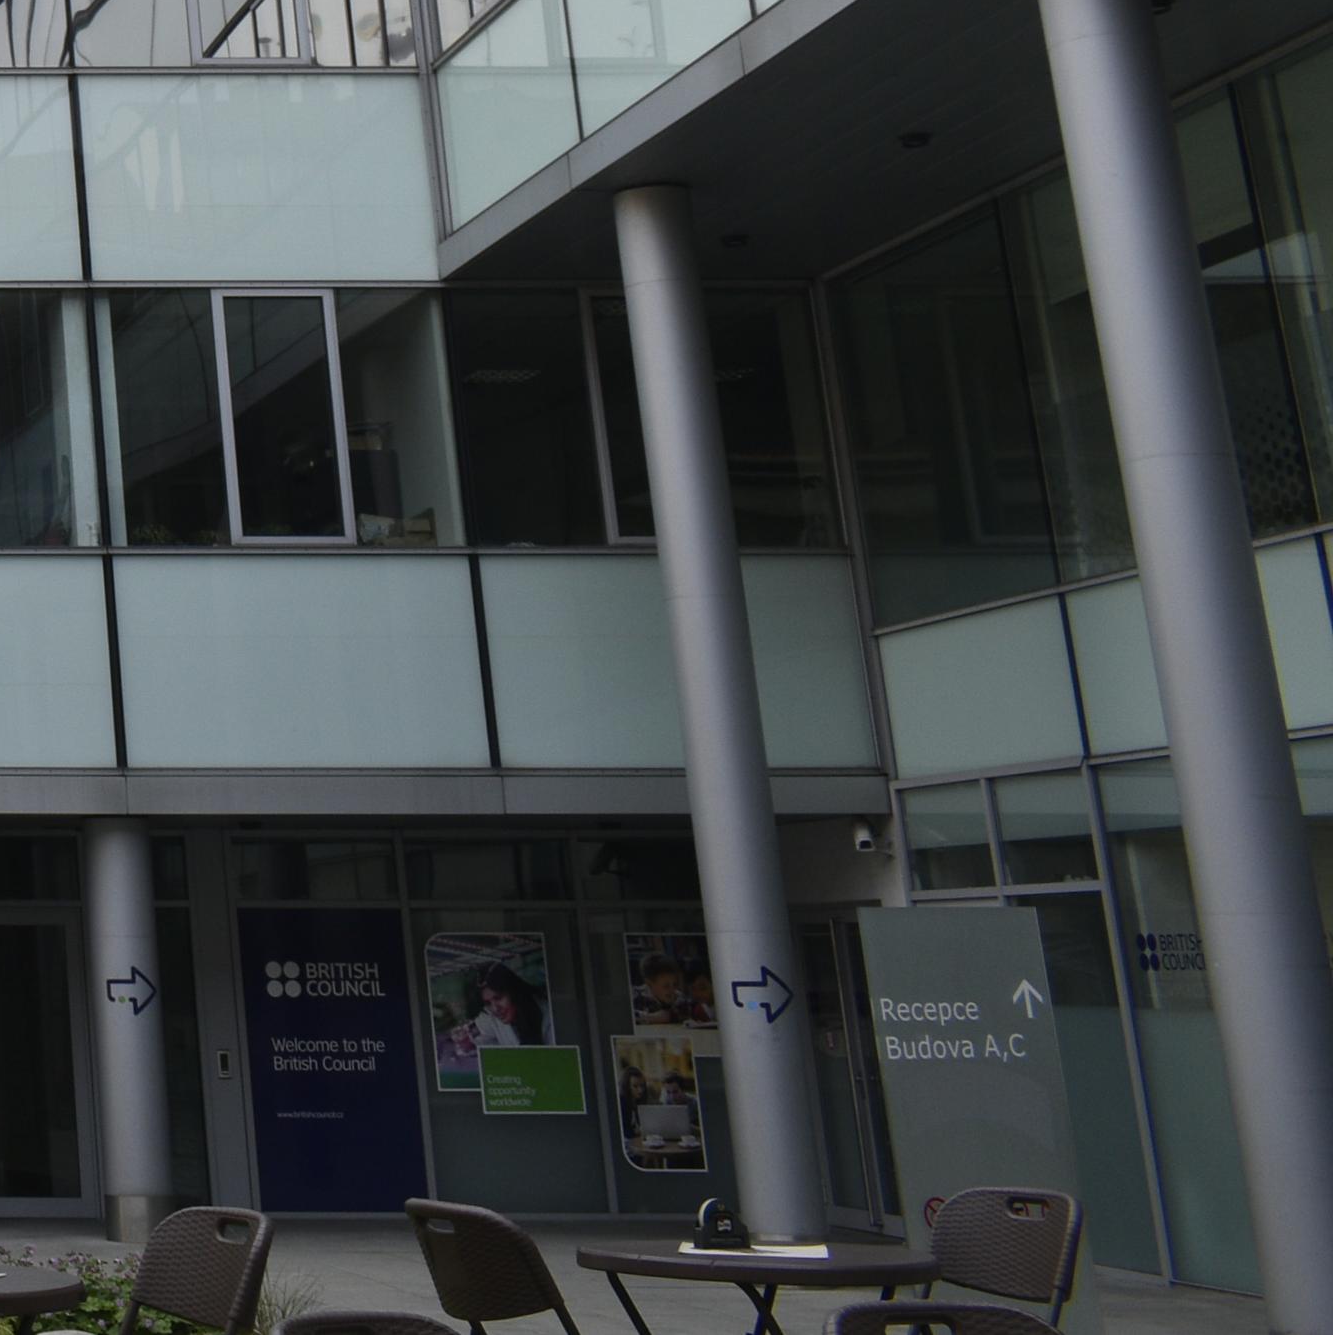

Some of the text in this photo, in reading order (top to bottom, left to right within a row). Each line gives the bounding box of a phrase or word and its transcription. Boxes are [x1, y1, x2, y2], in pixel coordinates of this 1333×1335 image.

[1162, 953, 1206, 970] COUNCI
[305, 962, 379, 979] BRITISH
[306, 980, 386, 997] COUNCIL
[879, 997, 979, 1026] Recepce
[271, 1037, 385, 1053] Welcome to the
[885, 1033, 1026, 1062] Budova A,C
[273, 1055, 376, 1072] British Council
